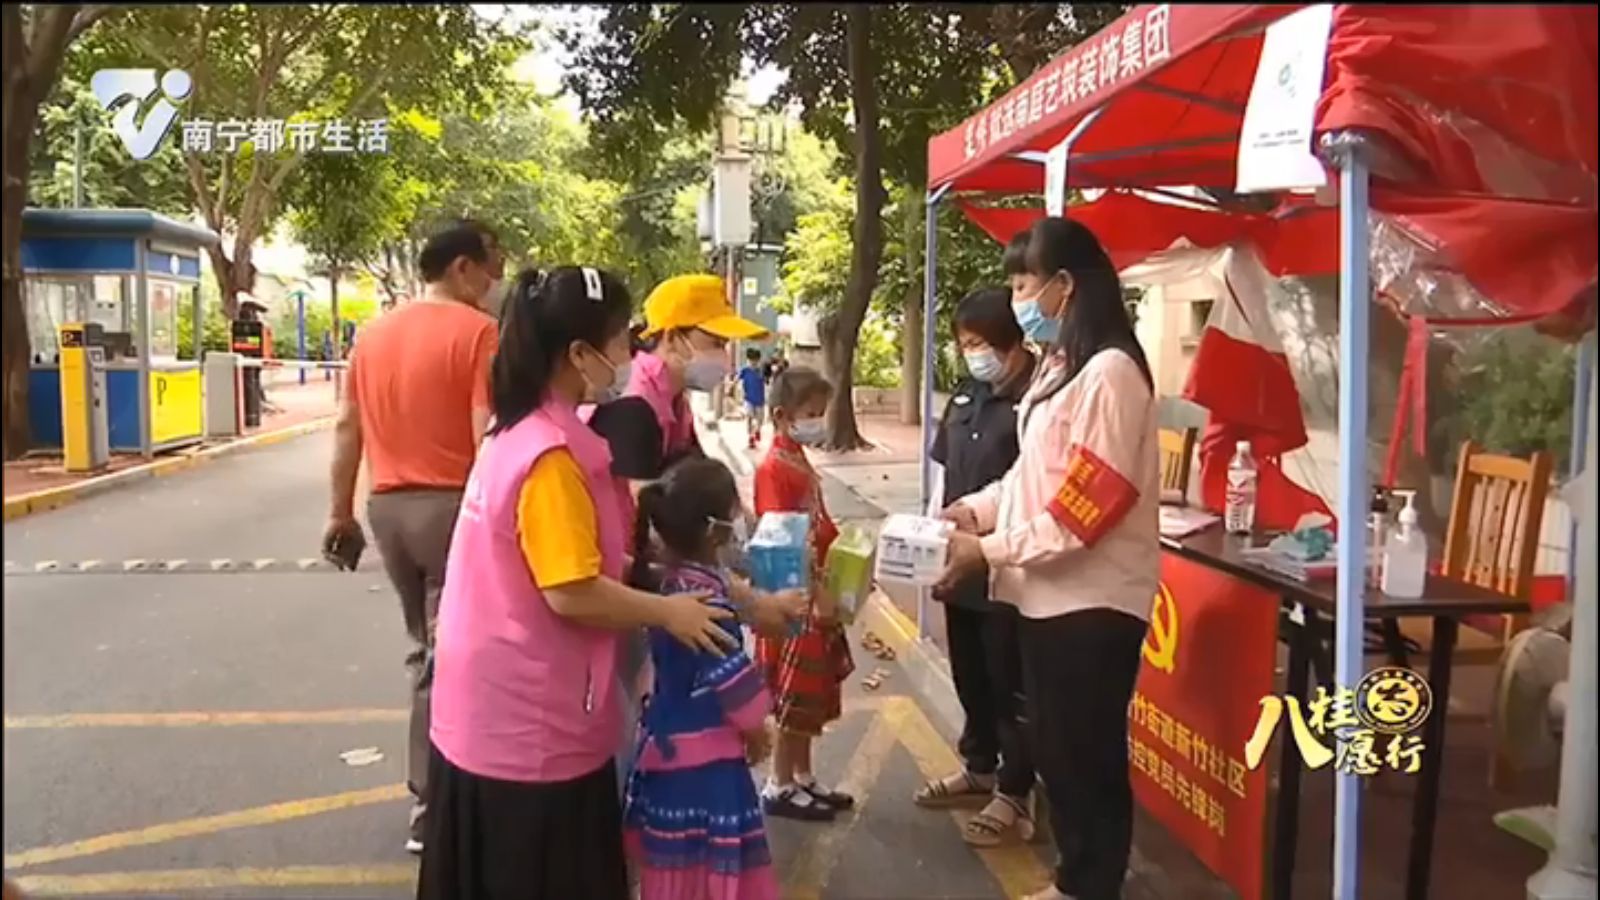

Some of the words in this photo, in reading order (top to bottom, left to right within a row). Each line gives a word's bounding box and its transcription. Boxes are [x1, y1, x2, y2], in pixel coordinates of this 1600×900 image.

[1128, 691, 1247, 799] 竹街道新竹社区
[1128, 736, 1226, 837] 控党员先锋岗
